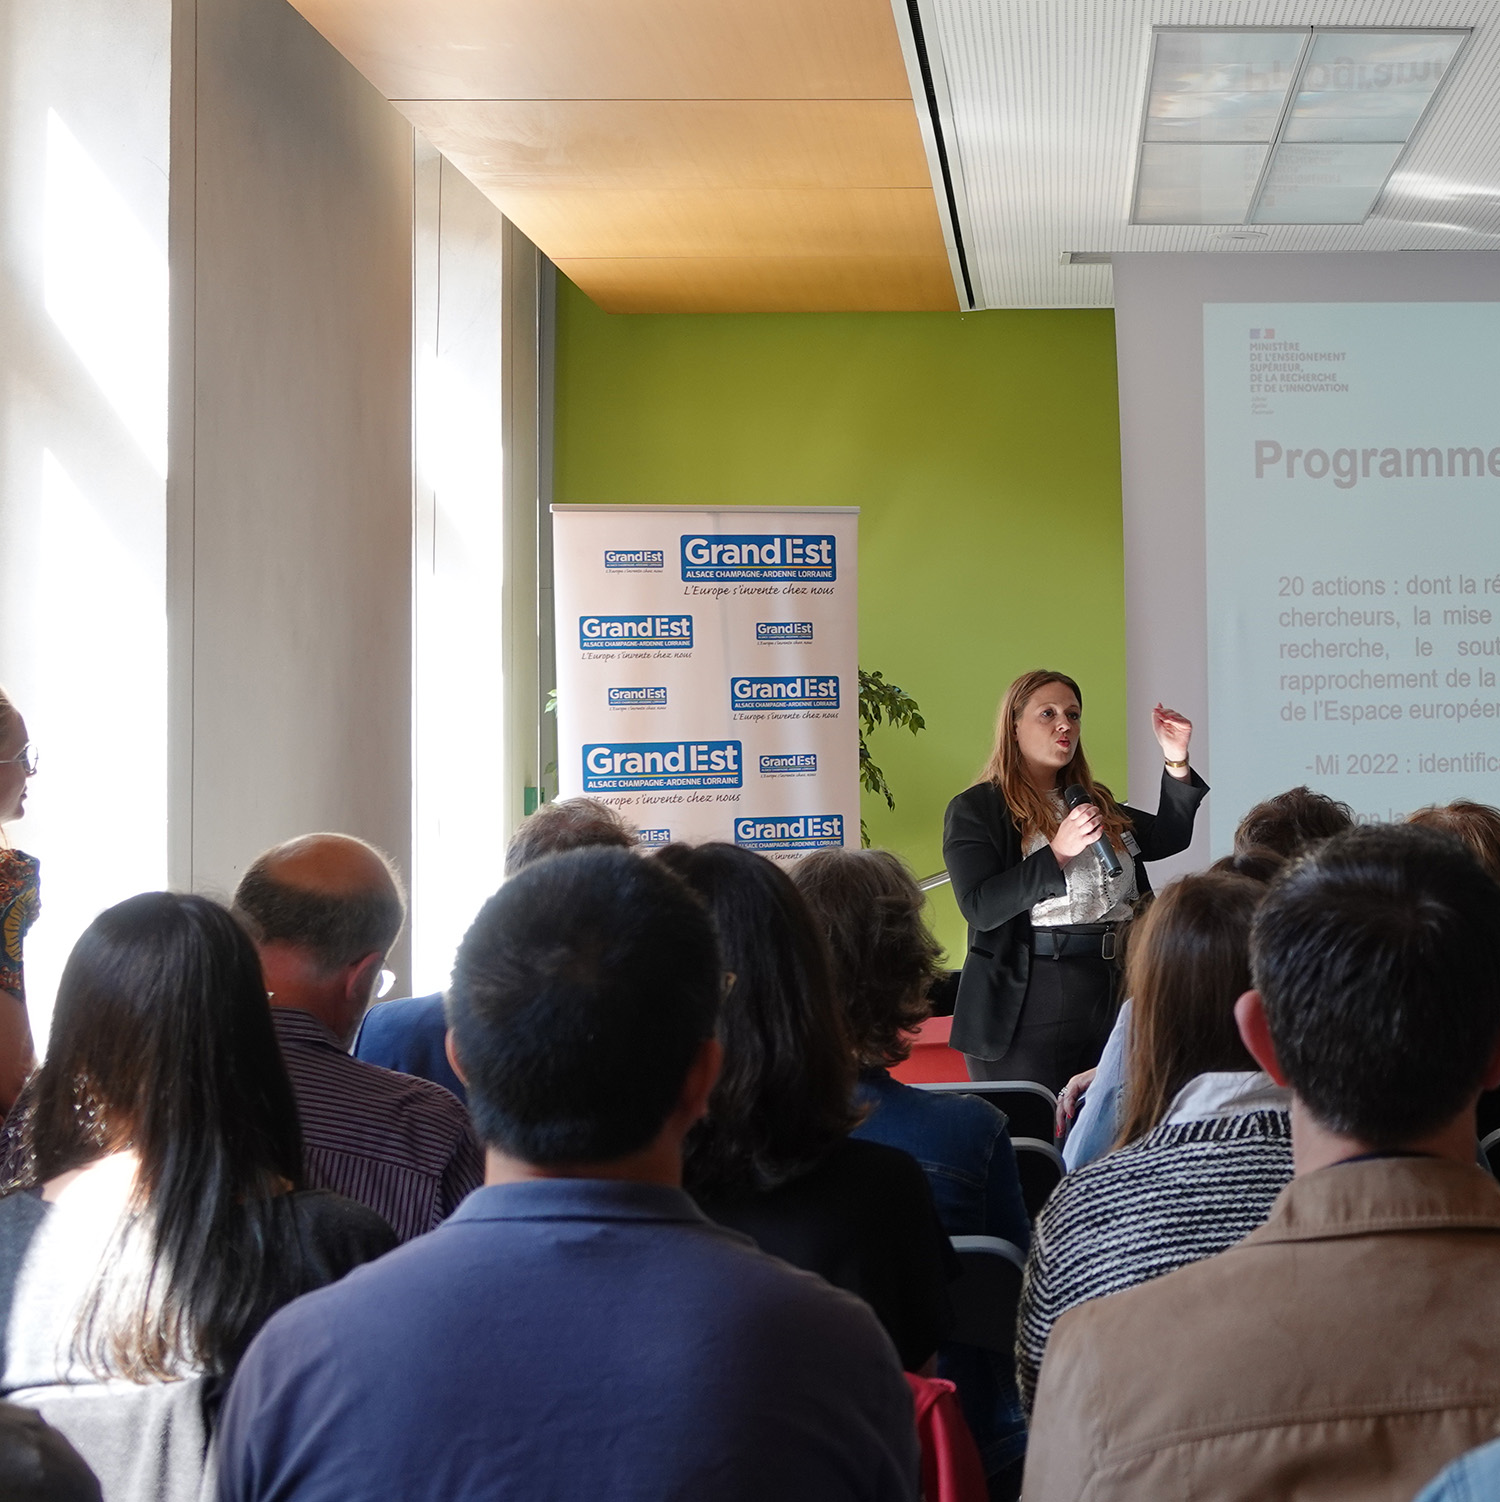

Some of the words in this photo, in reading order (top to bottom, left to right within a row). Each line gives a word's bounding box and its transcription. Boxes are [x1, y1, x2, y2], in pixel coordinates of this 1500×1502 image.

[1250, 341, 1300, 351] MINISTÈRE
[1250, 353, 1262, 362] DE
[1265, 352, 1346, 361] L'ENSEIGNEMENT
[1250, 362, 1304, 373] SUPÉRIEUR,
[1250, 374, 1262, 382] DE
[1265, 374, 1278, 382] LA
[1280, 373, 1337, 382] RECHERCHE
[1250, 384, 1262, 392] ET
[1264, 384, 1276, 392] DE
[1279, 384, 1348, 392] L'INNOVATION
[684, 585, 730, 600] L'Europe
[733, 584, 779, 595] s'invente
[782, 583, 808, 595] chez
[810, 586, 834, 595] nous
[1279, 575, 1304, 597] 20
[1312, 576, 1385, 596] actions
[1406, 575, 1452, 596] dont
[1459, 574, 1476, 595] la
[1279, 606, 1400, 629] chercheurs,
[1414, 605, 1431, 626] la
[1443, 604, 1492, 625] mise
[1280, 638, 1389, 660] recherche,
[1416, 636, 1433, 657] le
[581, 652, 615, 663] L'Europe
[617, 651, 651, 659] s'invente
[653, 650, 672, 658] chez
[1280, 668, 1438, 695] rapprochement
[1446, 667, 1471, 688] de
[1479, 667, 1496, 688] la
[733, 713, 766, 723] L'Europe
[802, 711, 820, 719] chez
[1280, 700, 1306, 722] de
[1314, 700, 1402, 726] l'Espace
[1347, 753, 1398, 775] 2022
[588, 780, 617, 788] ALSACE
[618, 778, 701, 787] CHAMPAGNE-ARDENNE
[703, 777, 738, 785] LORRAINE
[635, 794, 684, 805] s'invente
[686, 791, 712, 802] chez
[716, 793, 741, 802] nous
